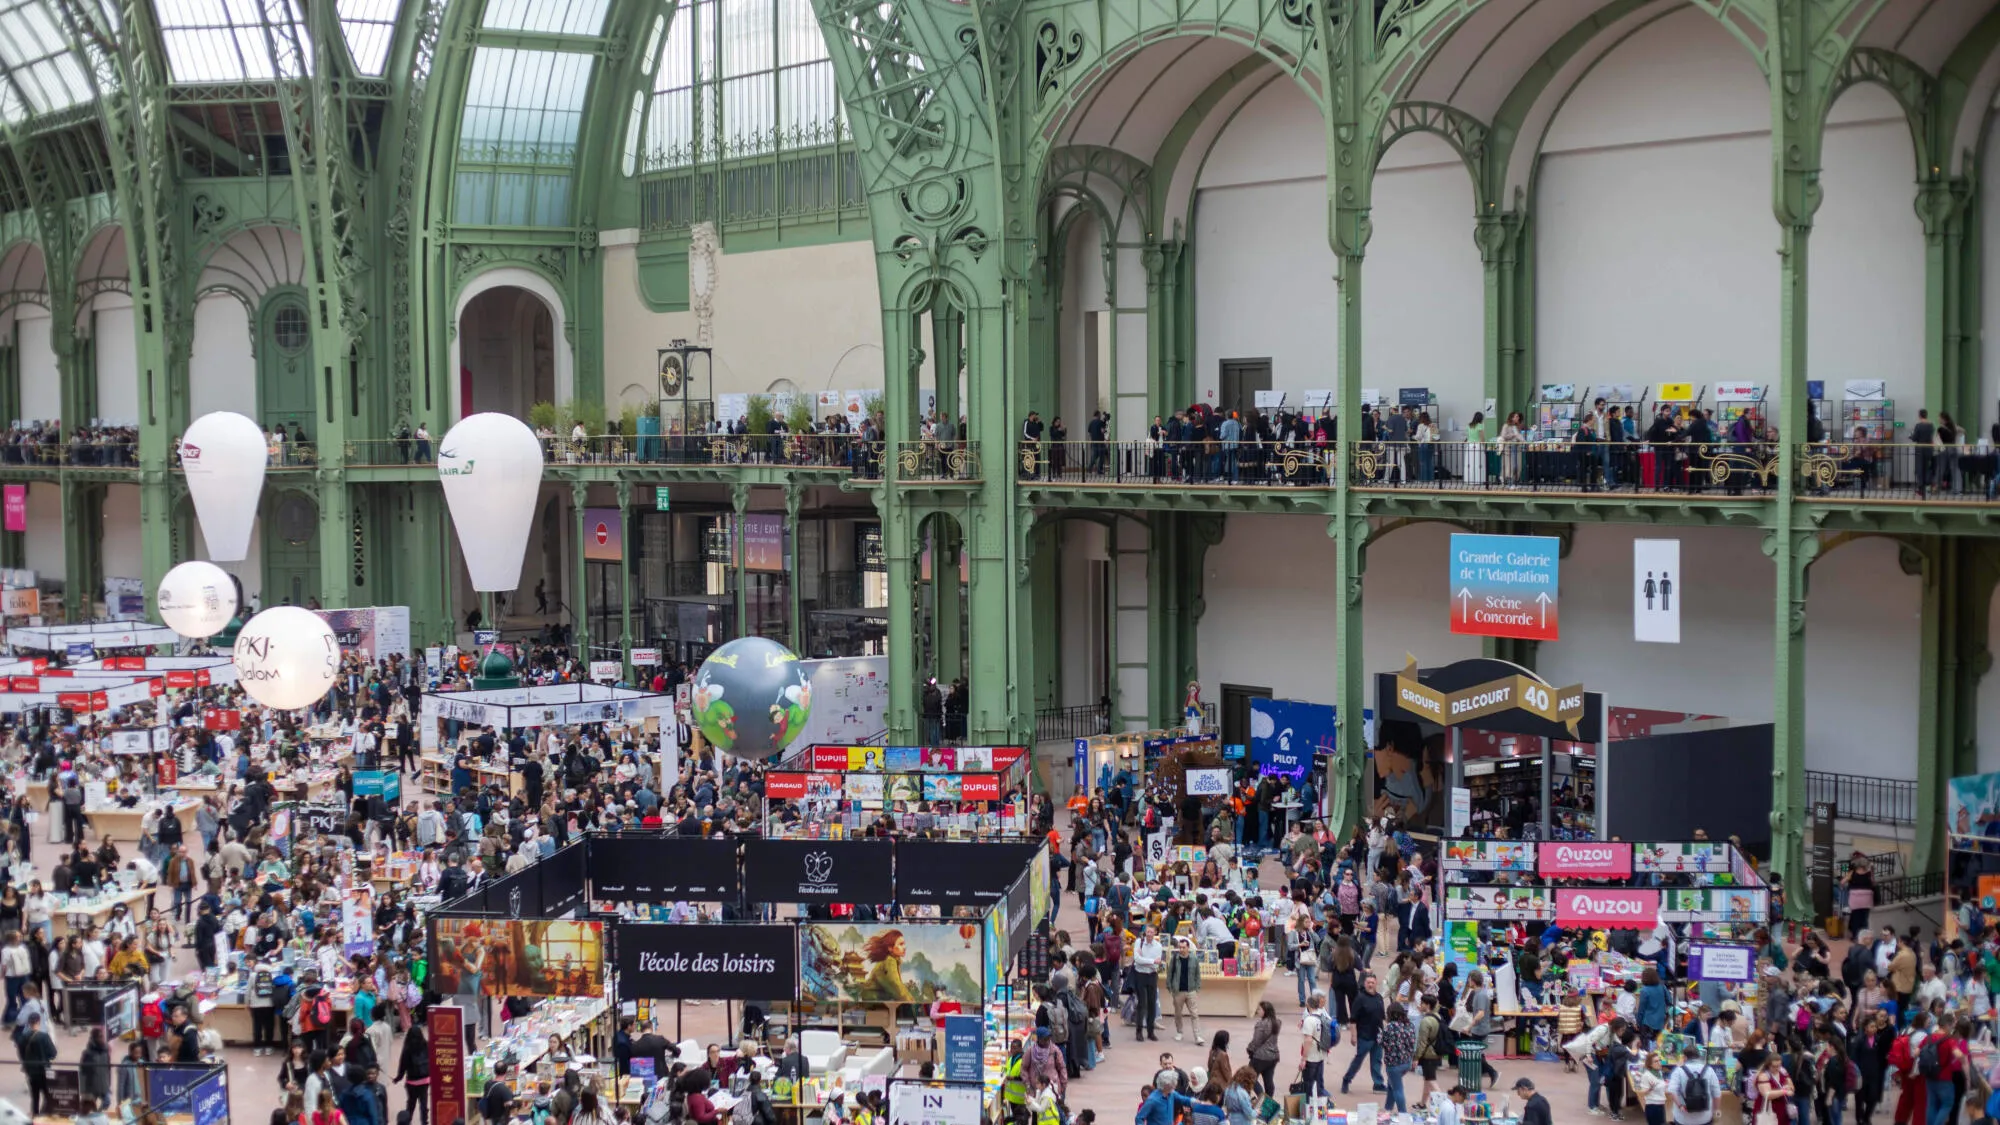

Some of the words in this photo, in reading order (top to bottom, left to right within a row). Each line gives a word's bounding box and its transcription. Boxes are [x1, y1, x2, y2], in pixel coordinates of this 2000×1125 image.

[734, 523, 758, 533] SRTIE
[764, 524, 779, 534] EXIT
[1459, 550, 1503, 565] Grande
[1507, 552, 1551, 567] Galerie
[1460, 567, 1475, 580] de
[1478, 567, 1549, 584] l'Adaptation
[1485, 595, 1522, 610] Scène
[1474, 610, 1534, 626] Concorde
[1401, 688, 1441, 714] GROUPE
[1451, 687, 1510, 714] DELCOURT
[1524, 686, 1549, 711] 40
[1558, 695, 1581, 711] ANS
[1273, 753, 1298, 765] PILOT
[963, 783, 997, 791] DUPUIS
[639, 951, 688, 972] l'école
[691, 952, 719, 973] des
[722, 952, 774, 973] loisirs
